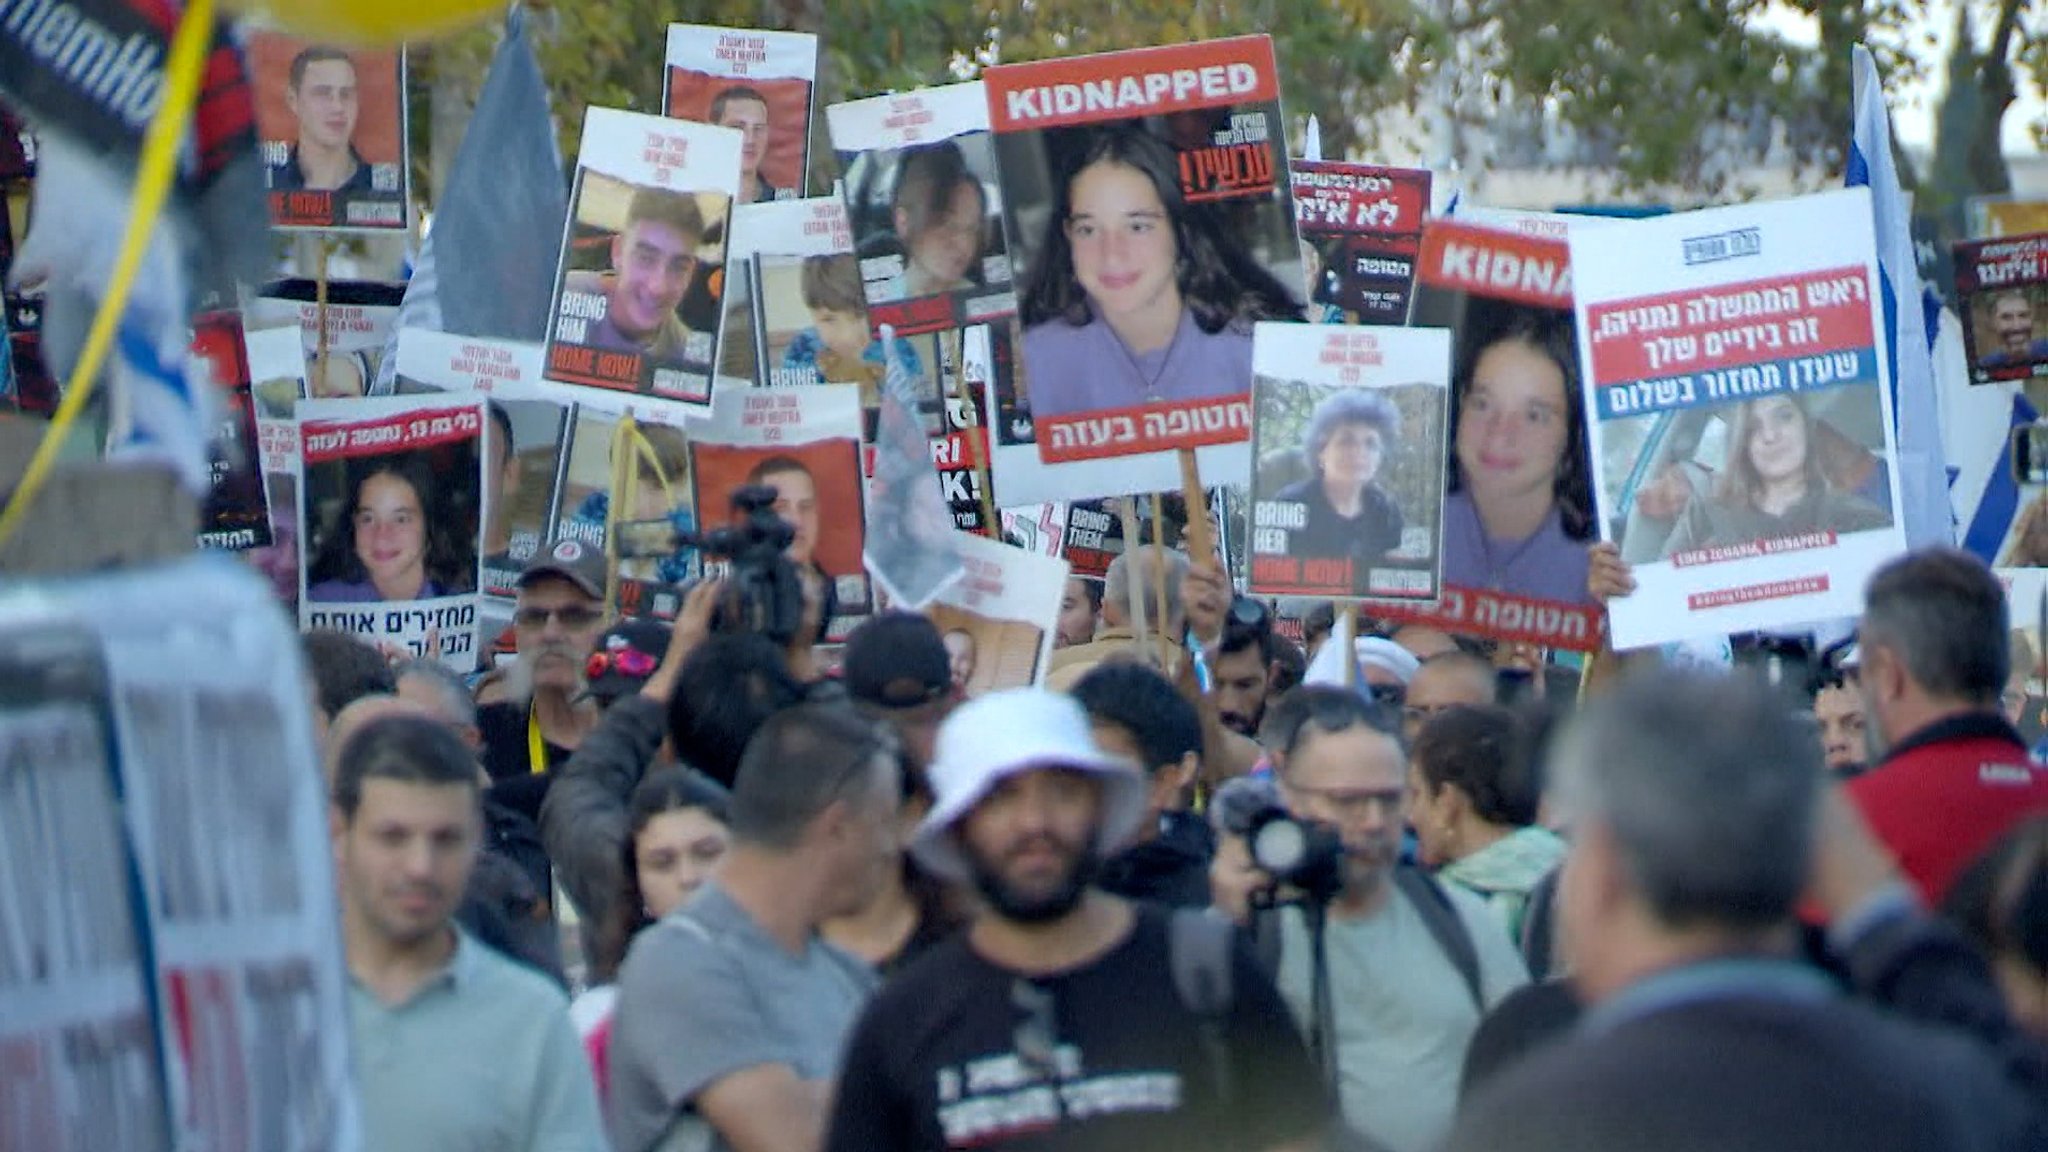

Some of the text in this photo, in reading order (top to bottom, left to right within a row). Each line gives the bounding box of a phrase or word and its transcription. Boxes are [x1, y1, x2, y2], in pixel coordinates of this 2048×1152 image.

[1007, 62, 1258, 120] KIDNAPPED
[1178, 142, 1273, 193] עכשיו!
[1355, 198, 1399, 226] לא
[1442, 241, 1573, 297] KIDNA
[561, 290, 607, 322] BRING
[1593, 275, 1866, 343] ראש הממשלה נתניהו,
[555, 316, 588, 345] HIM
[1643, 316, 1820, 370] זה בידיים שלך
[1609, 351, 1859, 413] שעדן תחזור בשלום
[1050, 401, 1250, 448] חטופה בעזה
[1070, 506, 1112, 533] BRING
[1254, 501, 1309, 531] BRING
[1068, 525, 1105, 550] THEM
[1253, 527, 1288, 555] HER
[385, 603, 475, 635] מחזירים
[1473, 594, 1587, 640] חטופה
